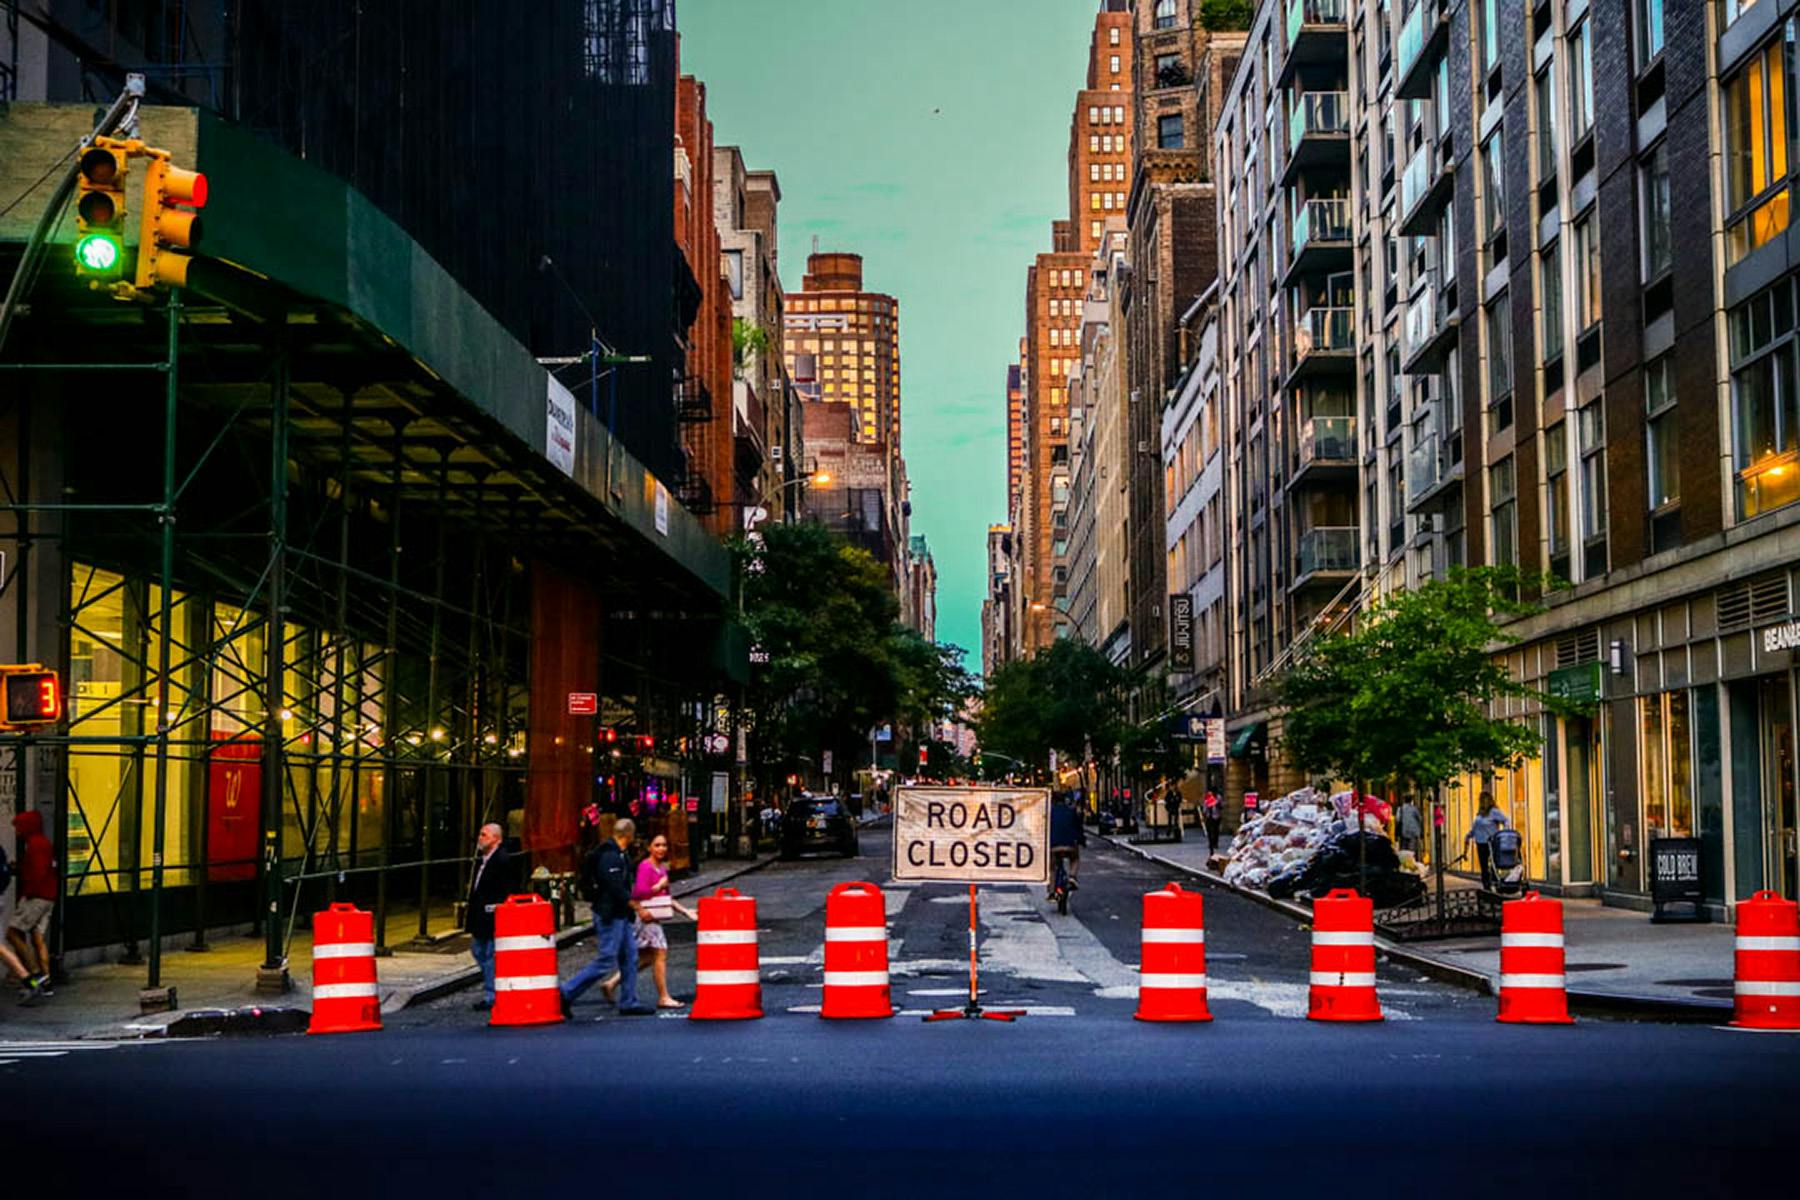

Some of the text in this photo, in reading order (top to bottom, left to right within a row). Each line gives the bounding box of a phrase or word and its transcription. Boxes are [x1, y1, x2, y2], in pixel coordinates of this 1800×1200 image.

[1175, 599, 1189, 649] JIU-JITSU
[41, 682, 54, 713] 3
[927, 802, 1015, 829] ROAD
[907, 840, 1034, 868] CLOSED
[1657, 854, 1697, 875] COLD BREW
